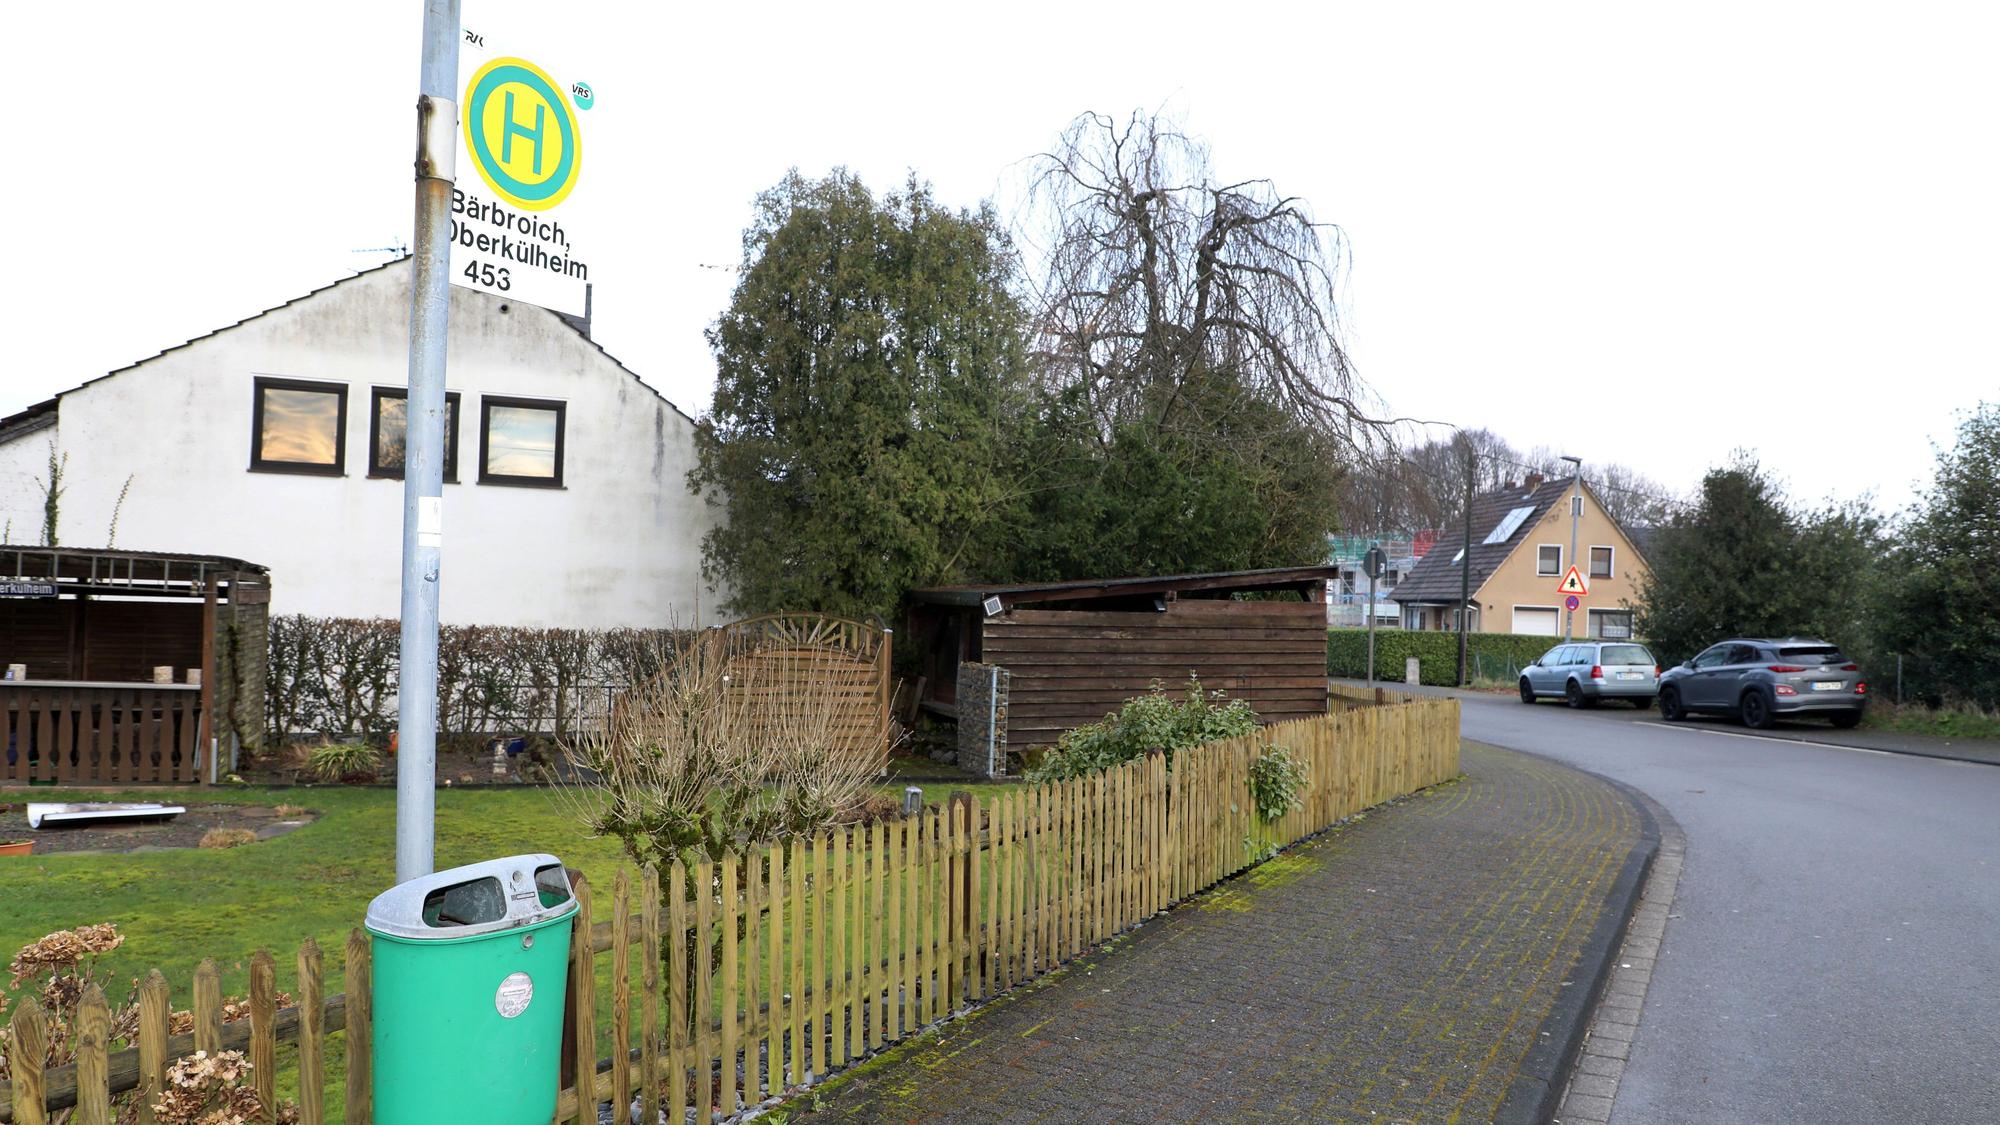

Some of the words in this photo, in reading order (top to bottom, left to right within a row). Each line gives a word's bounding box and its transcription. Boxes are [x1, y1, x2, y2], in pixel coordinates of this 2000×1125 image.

[572, 83, 589, 98] VRS
[502, 90, 545, 175] H
[452, 188, 570, 251] Bärbroich,
[464, 260, 511, 291] 453
